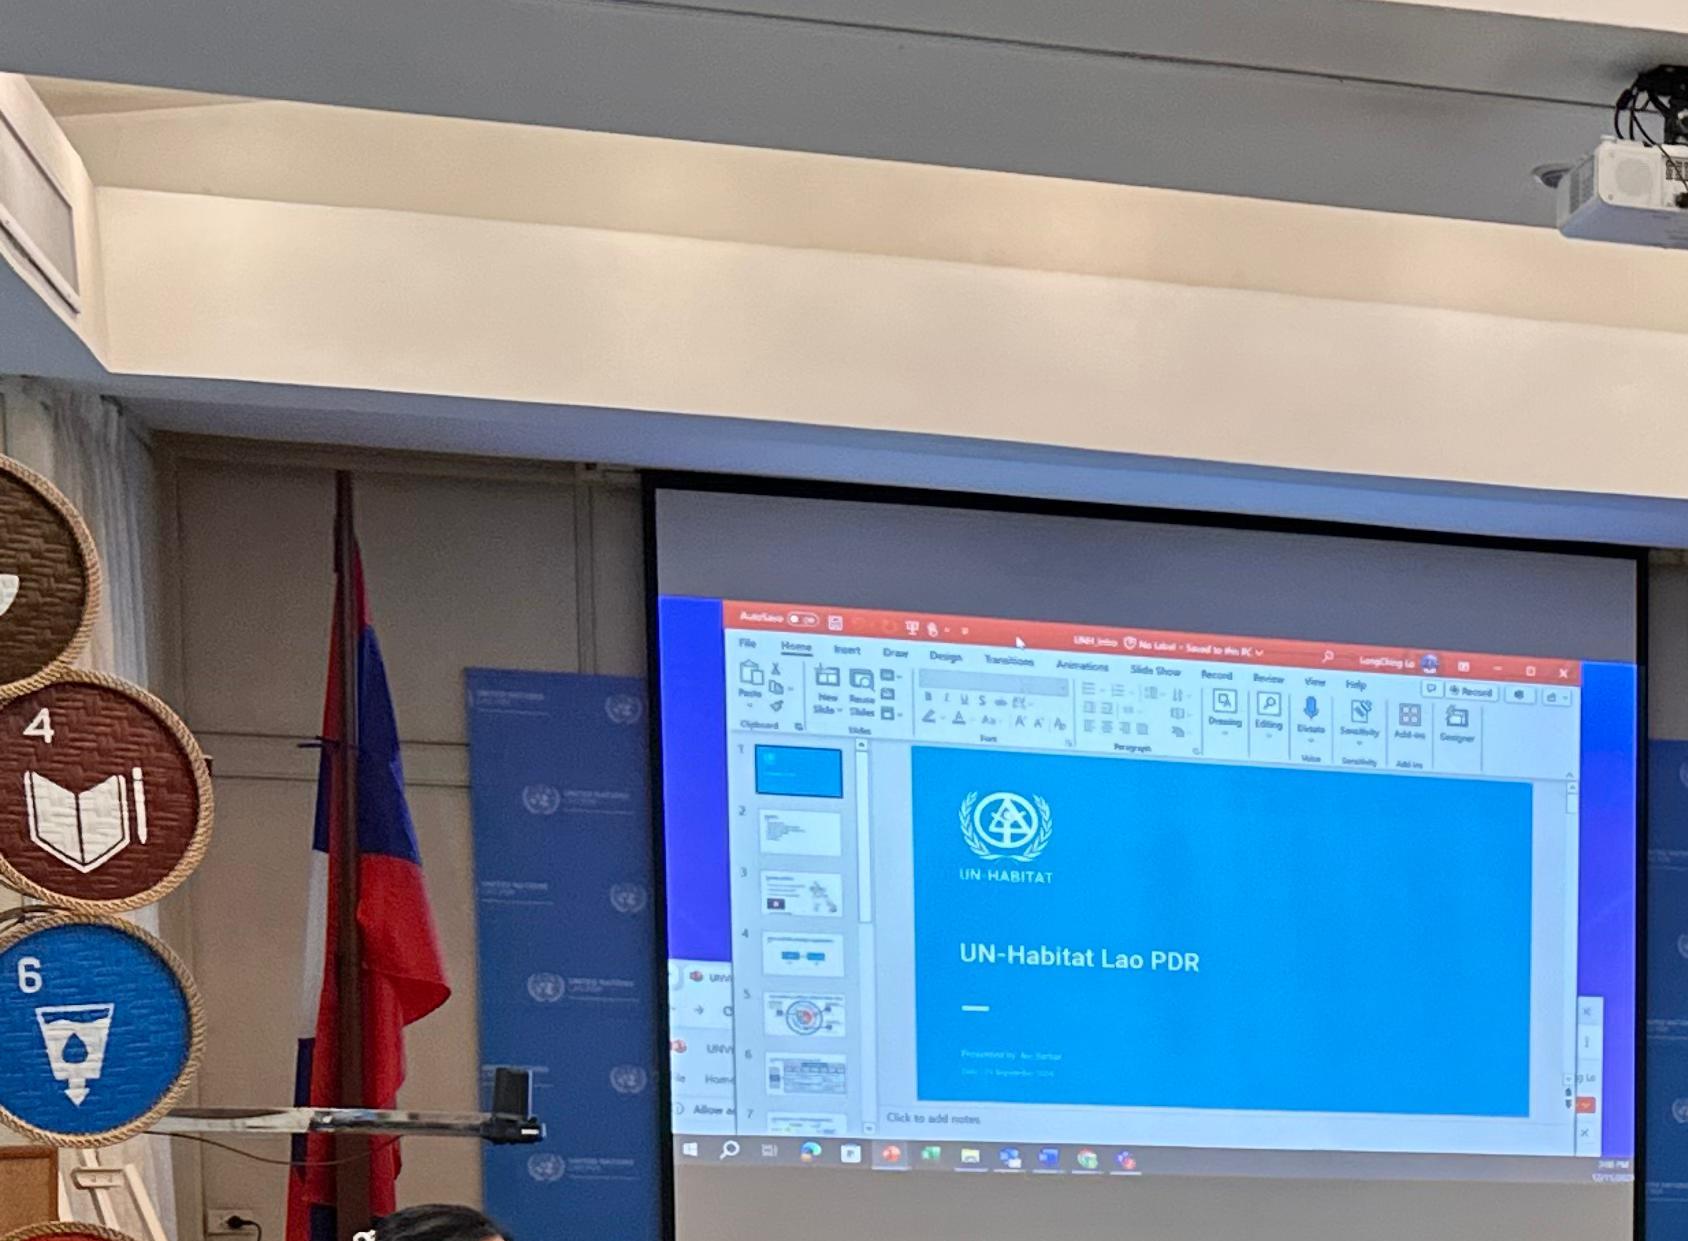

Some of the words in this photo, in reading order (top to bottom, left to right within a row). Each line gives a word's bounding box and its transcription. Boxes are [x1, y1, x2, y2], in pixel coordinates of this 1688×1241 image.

[739, 638, 757, 649] File
[781, 640, 812, 651] Home
[834, 644, 861, 655] Insert
[882, 647, 909, 658] Draw
[930, 650, 963, 664] Design
[985, 653, 1035, 667] Transitions
[1056, 659, 1110, 672] Animations
[1130, 664, 1154, 675] Slide
[1155, 666, 1182, 677] Show
[1201, 669, 1233, 681] Record
[1253, 673, 1285, 685] Review
[1304, 676, 1327, 687] View
[1345, 679, 1368, 693] Help
[1462, 686, 1493, 698] Record
[23, 708, 55, 744] 4
[1255, 718, 1284, 731] Editing
[738, 805, 746, 816] 2
[740, 866, 748, 877] 3
[959, 867, 1053, 884] UN-HABITAT
[741, 928, 749, 939] 4
[959, 942, 1095, 967] UN-Habitat
[1101, 948, 1144, 969] Lao
[1151, 950, 1200, 972] PDR
[17, 957, 43, 994] 6
[746, 1109, 755, 1118] 7
[886, 1111, 911, 1123] Click
[914, 1113, 925, 1123] to
[928, 1113, 949, 1124] add
[951, 1115, 981, 1125] notes
